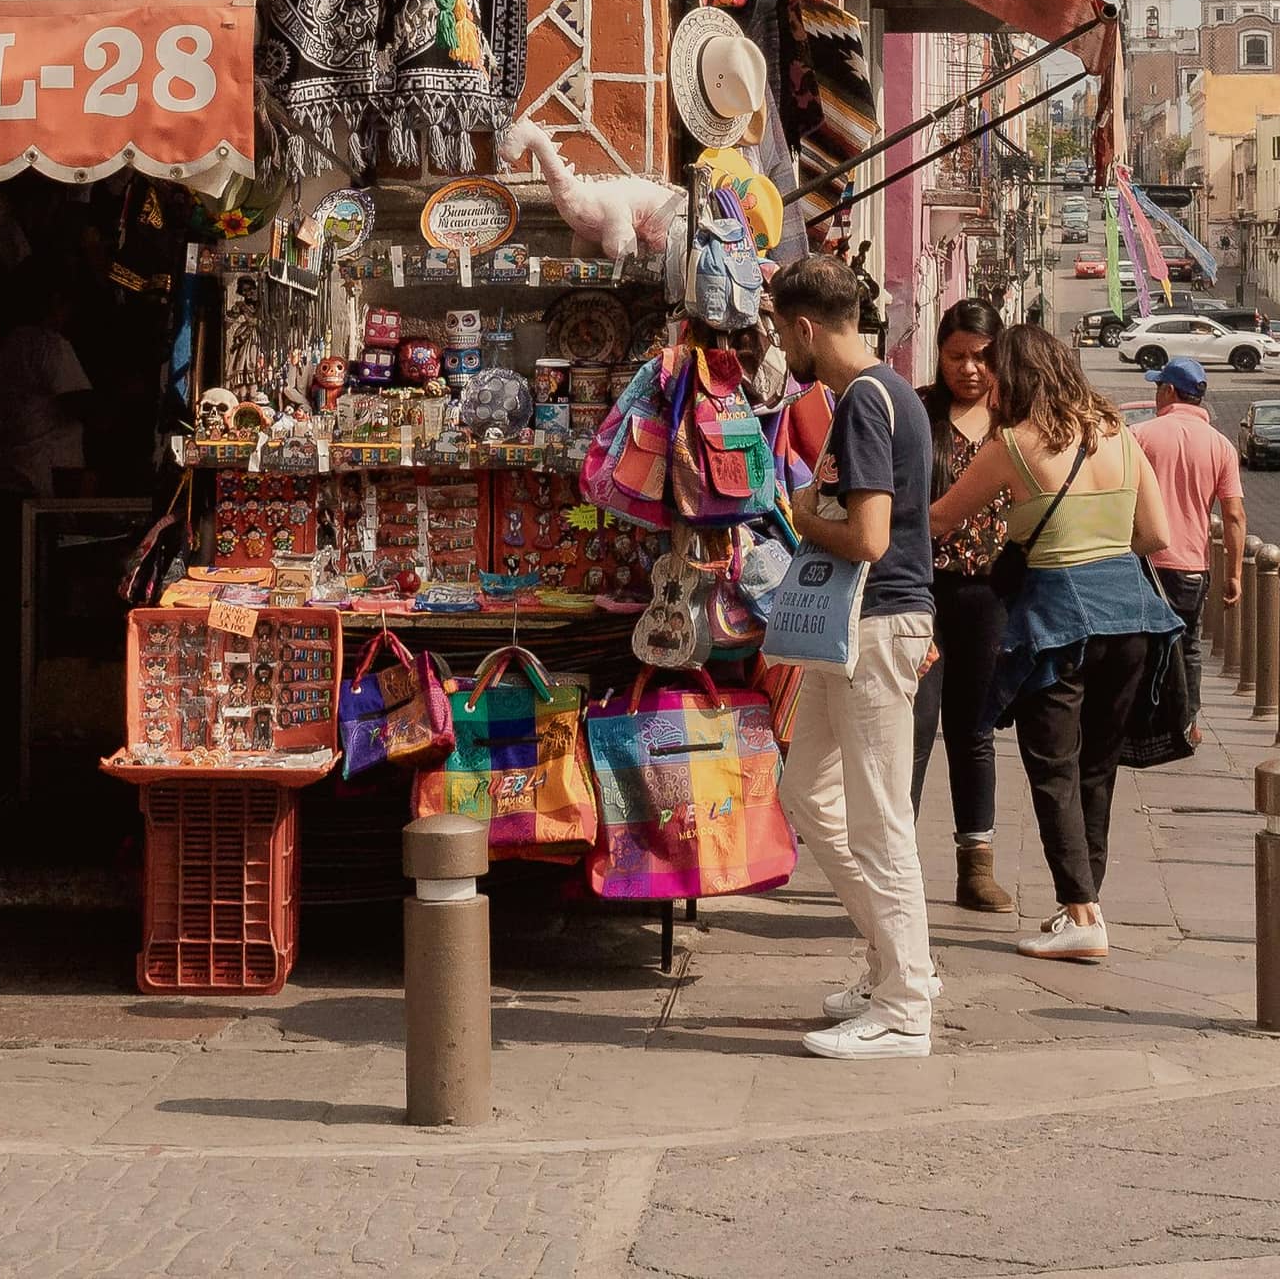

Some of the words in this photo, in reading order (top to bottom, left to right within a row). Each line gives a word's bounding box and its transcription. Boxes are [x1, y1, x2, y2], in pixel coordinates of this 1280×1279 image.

[780, 592, 814, 607] SHRIMP
[817, 595, 830, 609] CO.
[773, 611, 825, 634] CHICAGO
